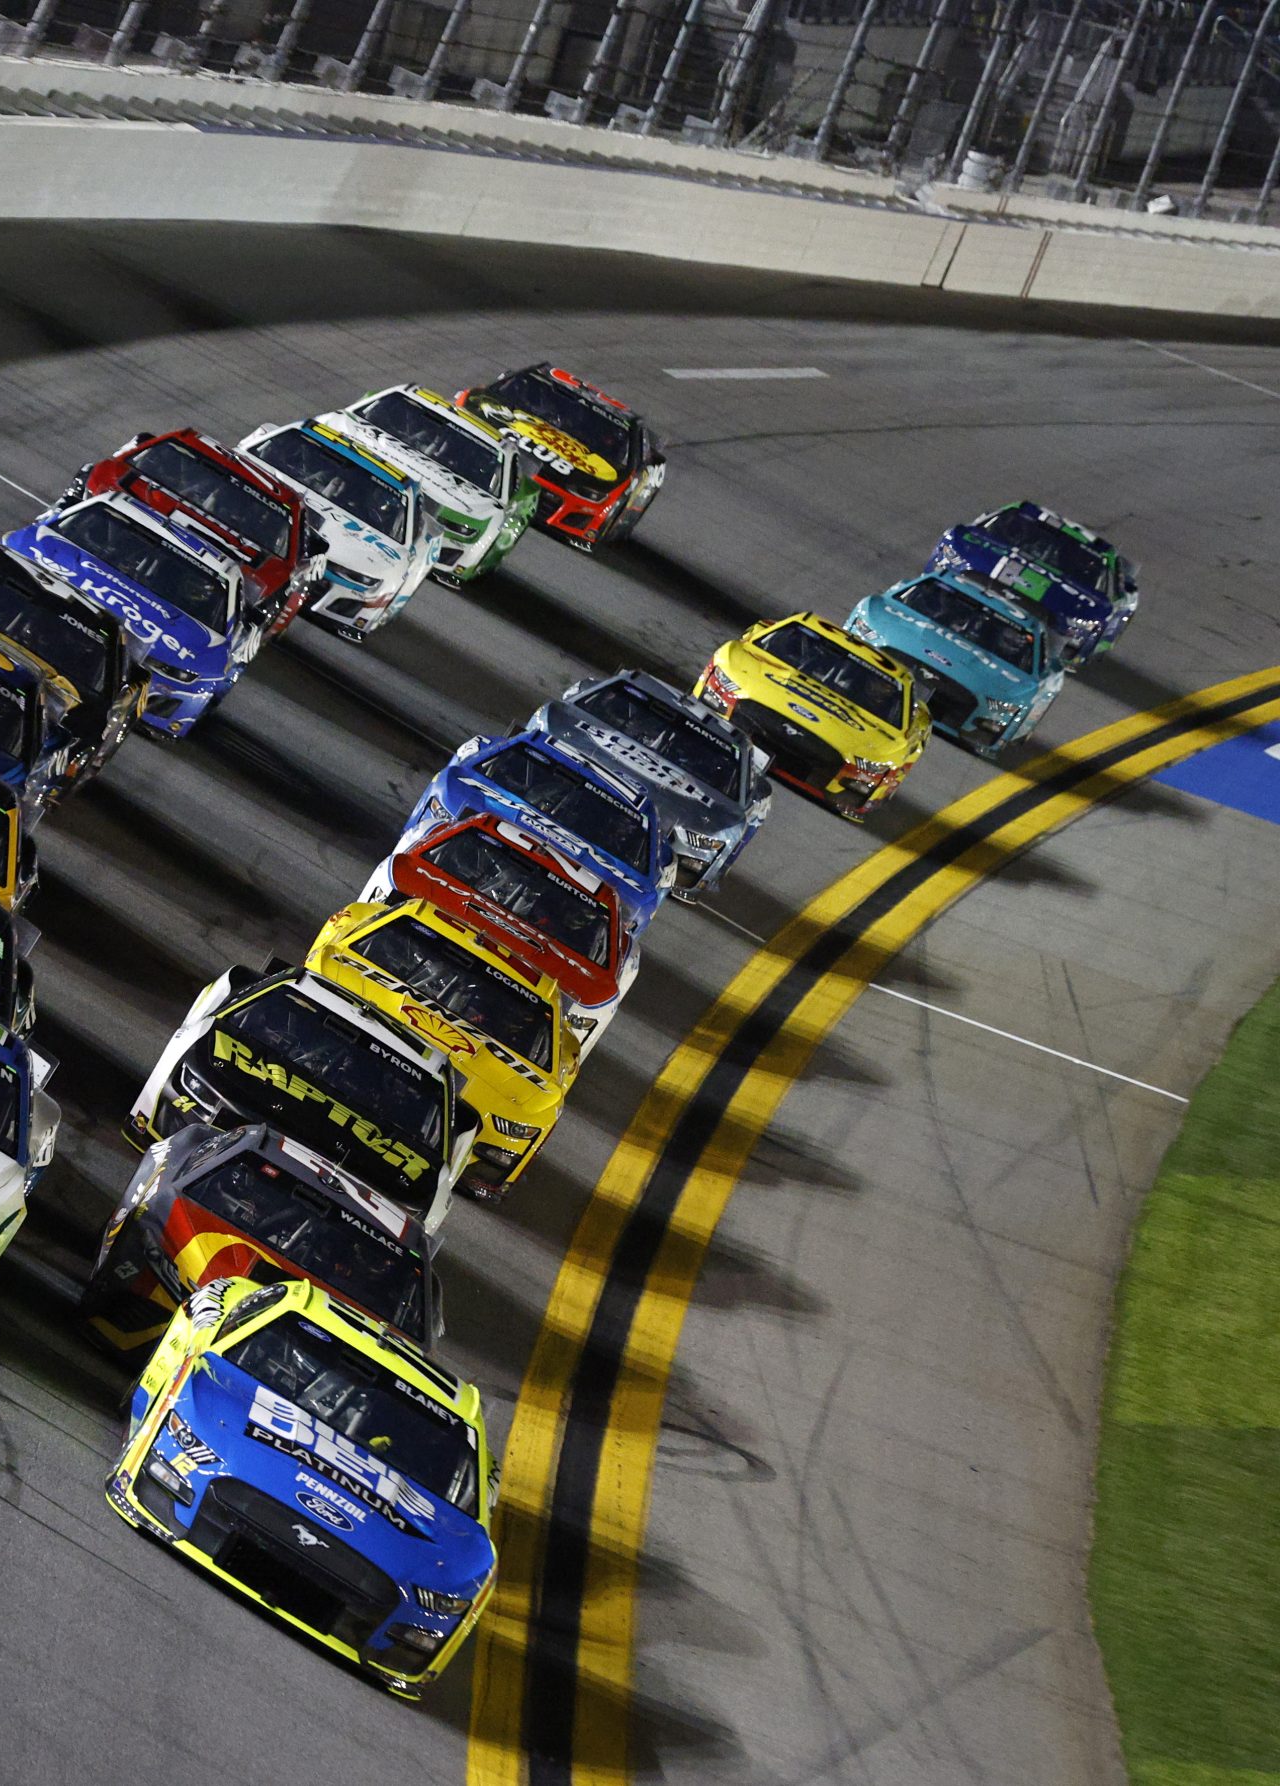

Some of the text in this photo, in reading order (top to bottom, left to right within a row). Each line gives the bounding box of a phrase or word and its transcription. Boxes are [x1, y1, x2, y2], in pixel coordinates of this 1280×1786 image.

[498, 427, 575, 475] CLUB
[229, 475, 288, 513] T. DILLON
[80, 560, 172, 620] Cottonelle
[58, 612, 105, 645] JONES
[80, 576, 196, 661] Kroger
[685, 720, 732, 751] HARVICK
[574, 719, 715, 808] BUSCH
[584, 781, 642, 822] BUESCHER
[457, 777, 643, 893] FASTENAL
[522, 815, 580, 855] MSA
[547, 872, 597, 908] BURTON
[485, 966, 539, 1004] LOGANO
[332, 954, 553, 1093] PENNZOIL
[370, 1042, 422, 1081] BYRON
[172, 1095, 197, 1113] 24
[213, 1029, 431, 1181] RAPTOR
[339, 1210, 403, 1257] WALLACE
[394, 1379, 460, 1426] BLANEY
[170, 1451, 199, 1478] 12
[251, 1426, 407, 1531] PLATINUM
[295, 1471, 367, 1524] PENNZOIL
